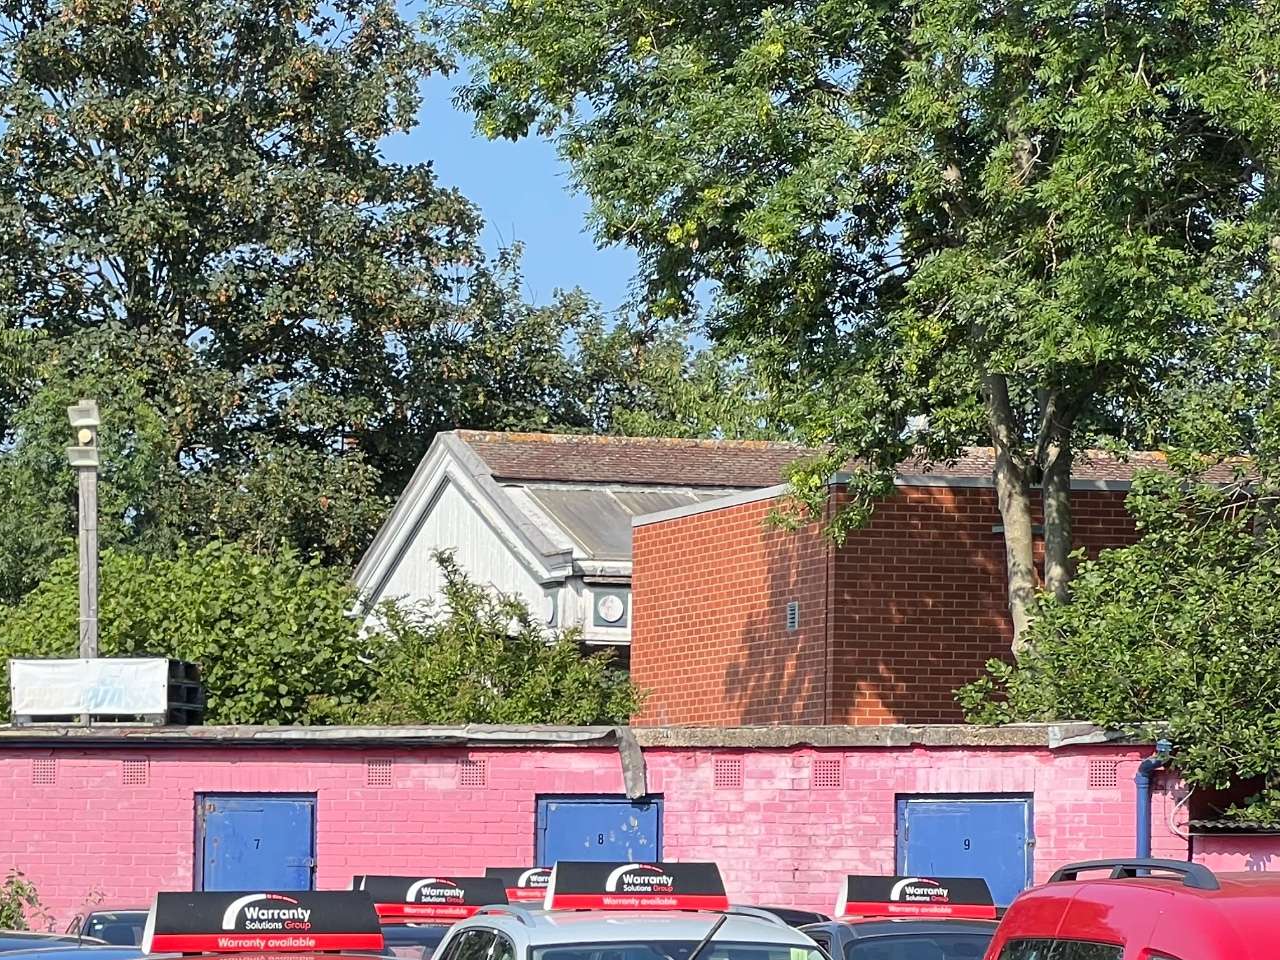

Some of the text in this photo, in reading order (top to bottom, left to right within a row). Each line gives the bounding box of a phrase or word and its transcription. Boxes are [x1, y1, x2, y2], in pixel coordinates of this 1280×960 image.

[254, 838, 261, 850] 7
[598, 833, 604, 845] 8
[964, 838, 970, 851] 9
[622, 874, 674, 887] Warranty
[421, 887, 465, 899] Warranty
[623, 884, 652, 892] Solutions
[904, 886, 949, 897] Warranty
[602, 897, 678, 907] Warranty available
[244, 906, 311, 923] Warranty
[245, 920, 312, 931] Solutions Group
[218, 937, 316, 950] Warranty available
